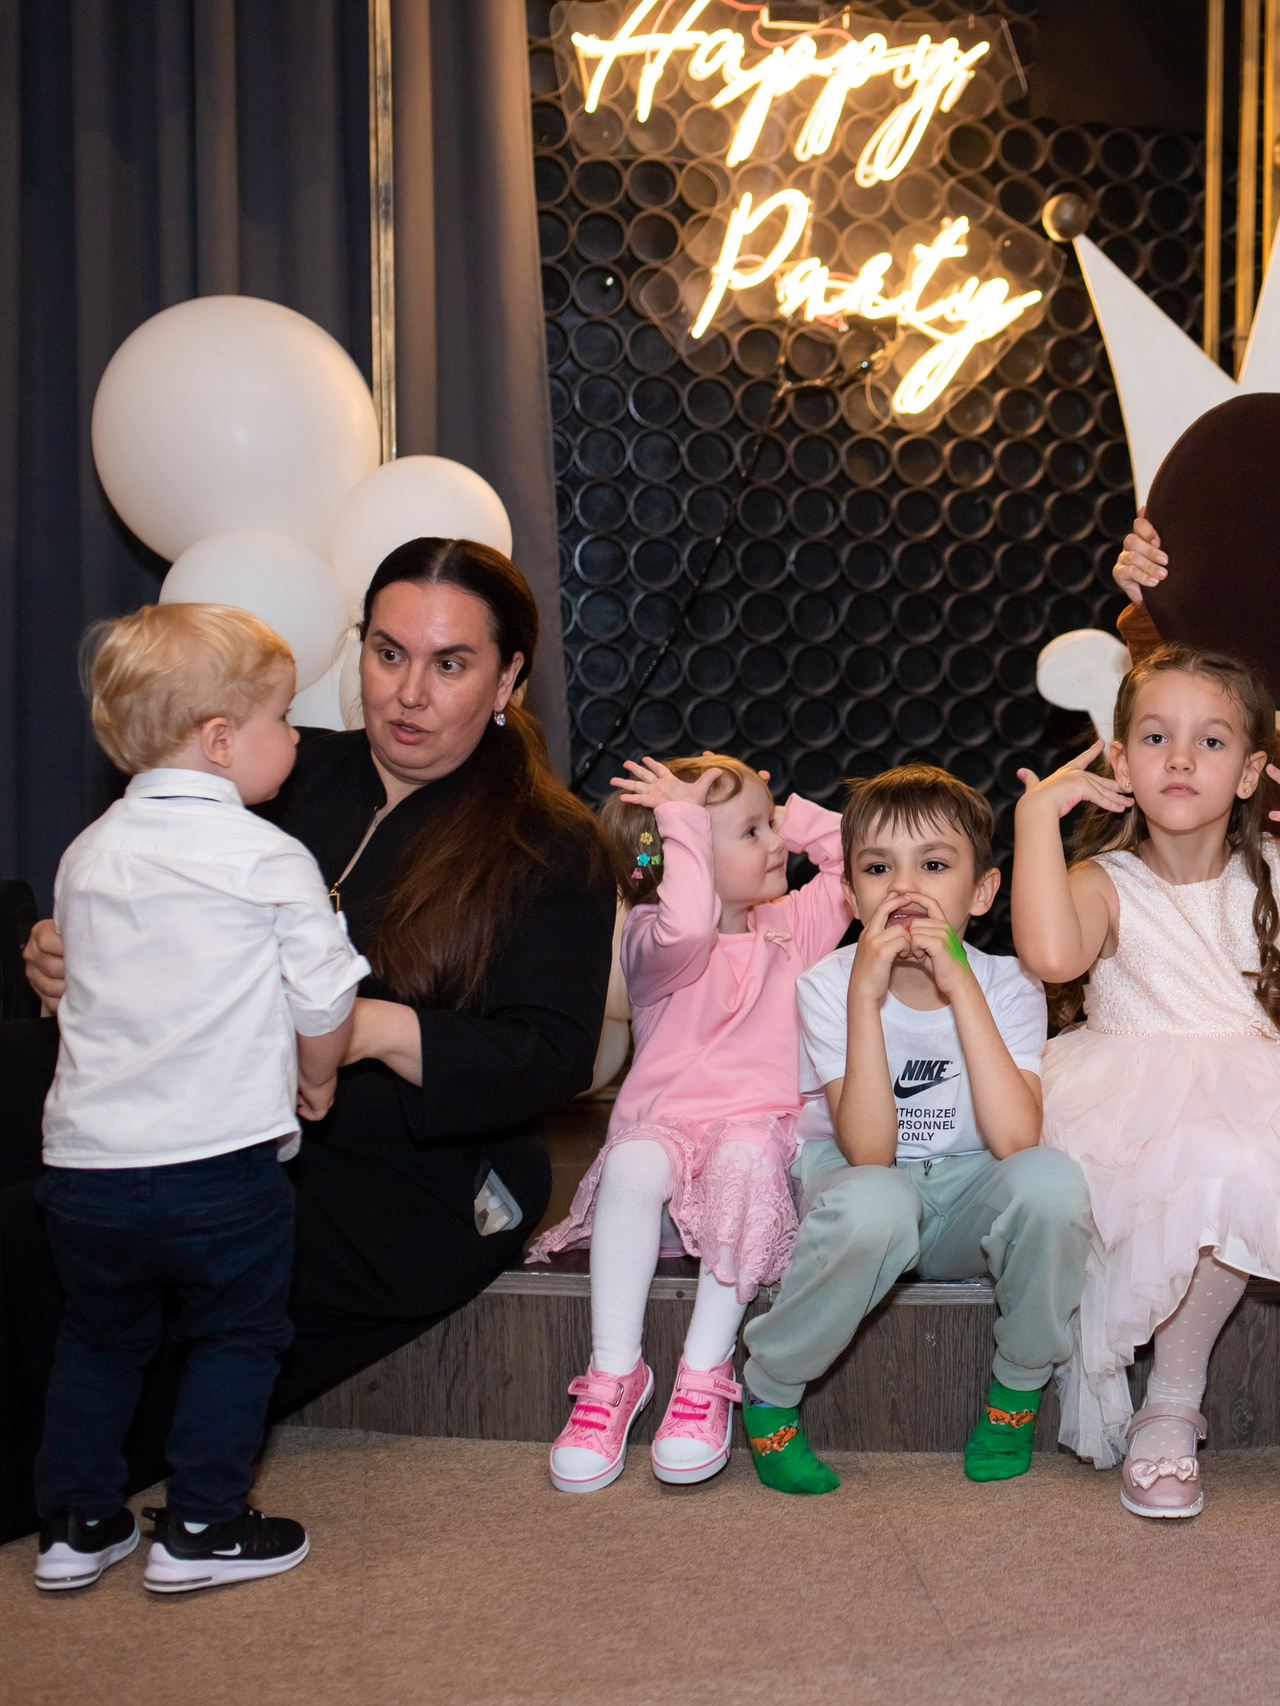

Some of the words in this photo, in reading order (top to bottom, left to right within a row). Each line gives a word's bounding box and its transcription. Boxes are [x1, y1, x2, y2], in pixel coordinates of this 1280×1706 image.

[571, 0, 990, 187] Happy
[691, 188, 1042, 415] Party
[900, 1059, 950, 1081] NIKE
[896, 1107, 957, 1118] THORIZED
[898, 1119, 955, 1130] RSONNEL
[901, 1131, 935, 1141] ONLY
